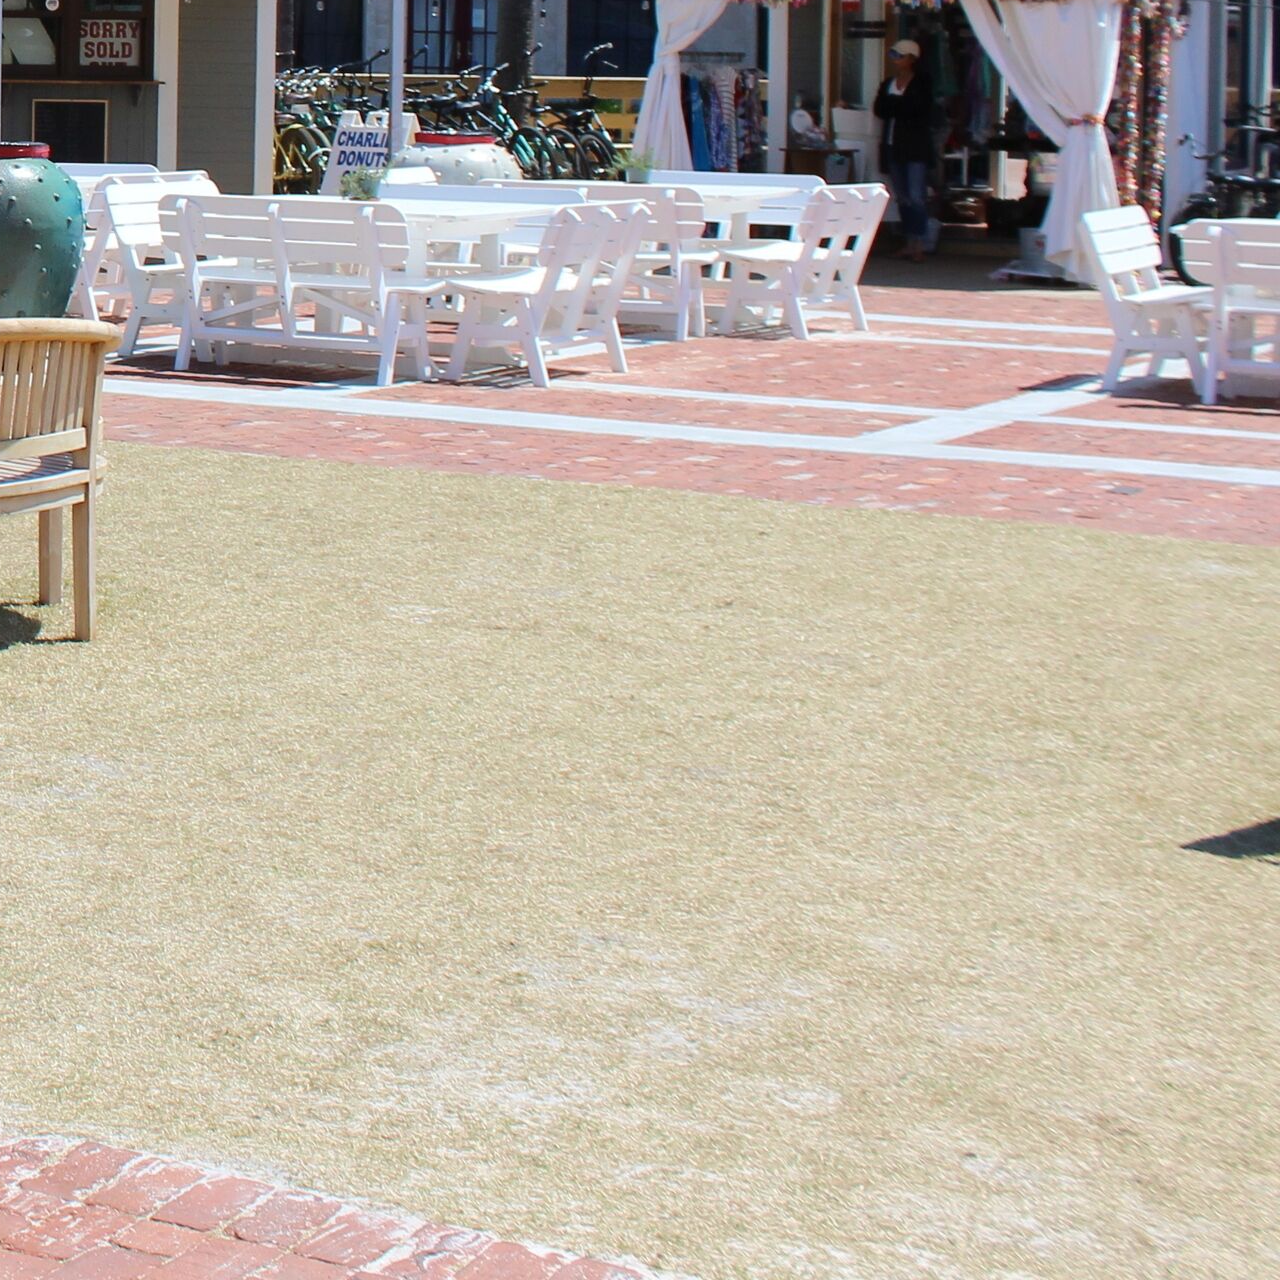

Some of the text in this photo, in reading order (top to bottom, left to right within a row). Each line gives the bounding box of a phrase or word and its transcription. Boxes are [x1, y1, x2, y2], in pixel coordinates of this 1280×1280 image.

[79, 21, 140, 38] SORRY
[84, 41, 133, 59] SOLD
[337, 131, 389, 148] CHARLI
